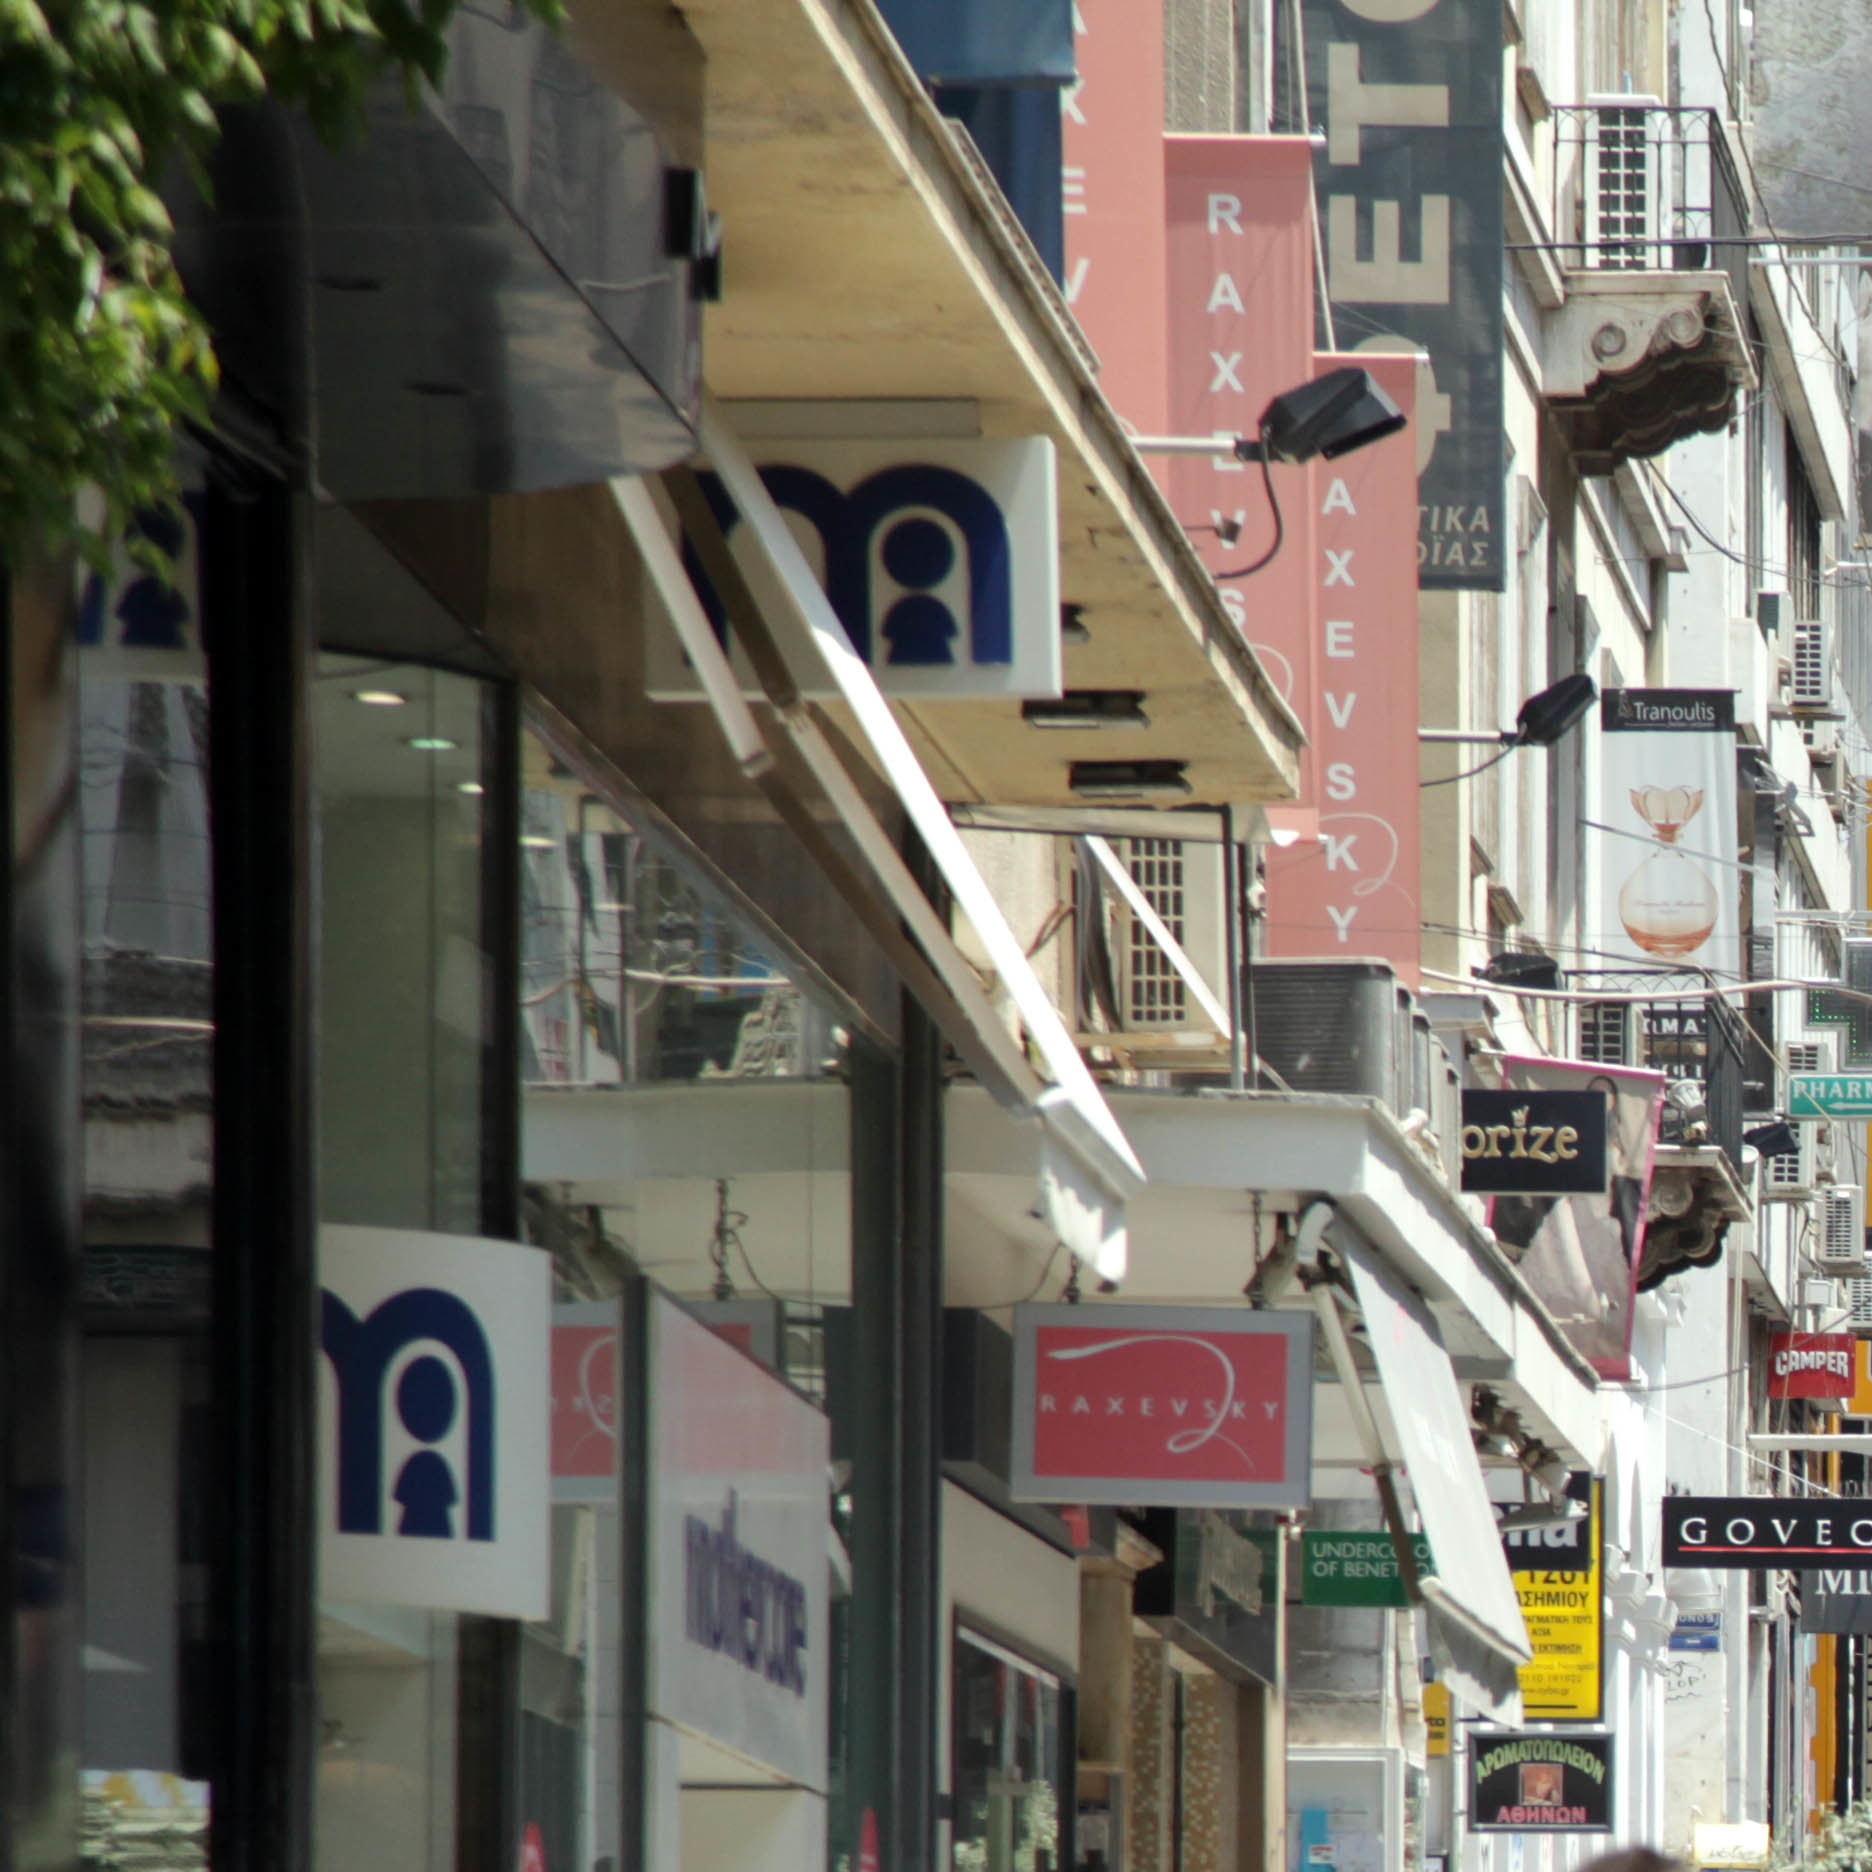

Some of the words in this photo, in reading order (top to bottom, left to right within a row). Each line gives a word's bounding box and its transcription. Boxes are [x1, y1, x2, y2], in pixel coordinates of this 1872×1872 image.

[1321, 478, 1359, 943] AXEVSKY
[1633, 701, 1716, 721] Tranoulis
[1775, 1350, 1849, 1378] CAMPER
[1041, 1397, 1279, 1421] RAXEVSKY
[1312, 1541, 1436, 1559] UNDERCO
[1312, 1561, 1339, 1579] OF
[1475, 1738, 1606, 1785] ΑΡΩΜΑΤΟΠΩΛΕΙΟΝ
[1497, 1804, 1588, 1824] ΑΘΗΝΩΝ
